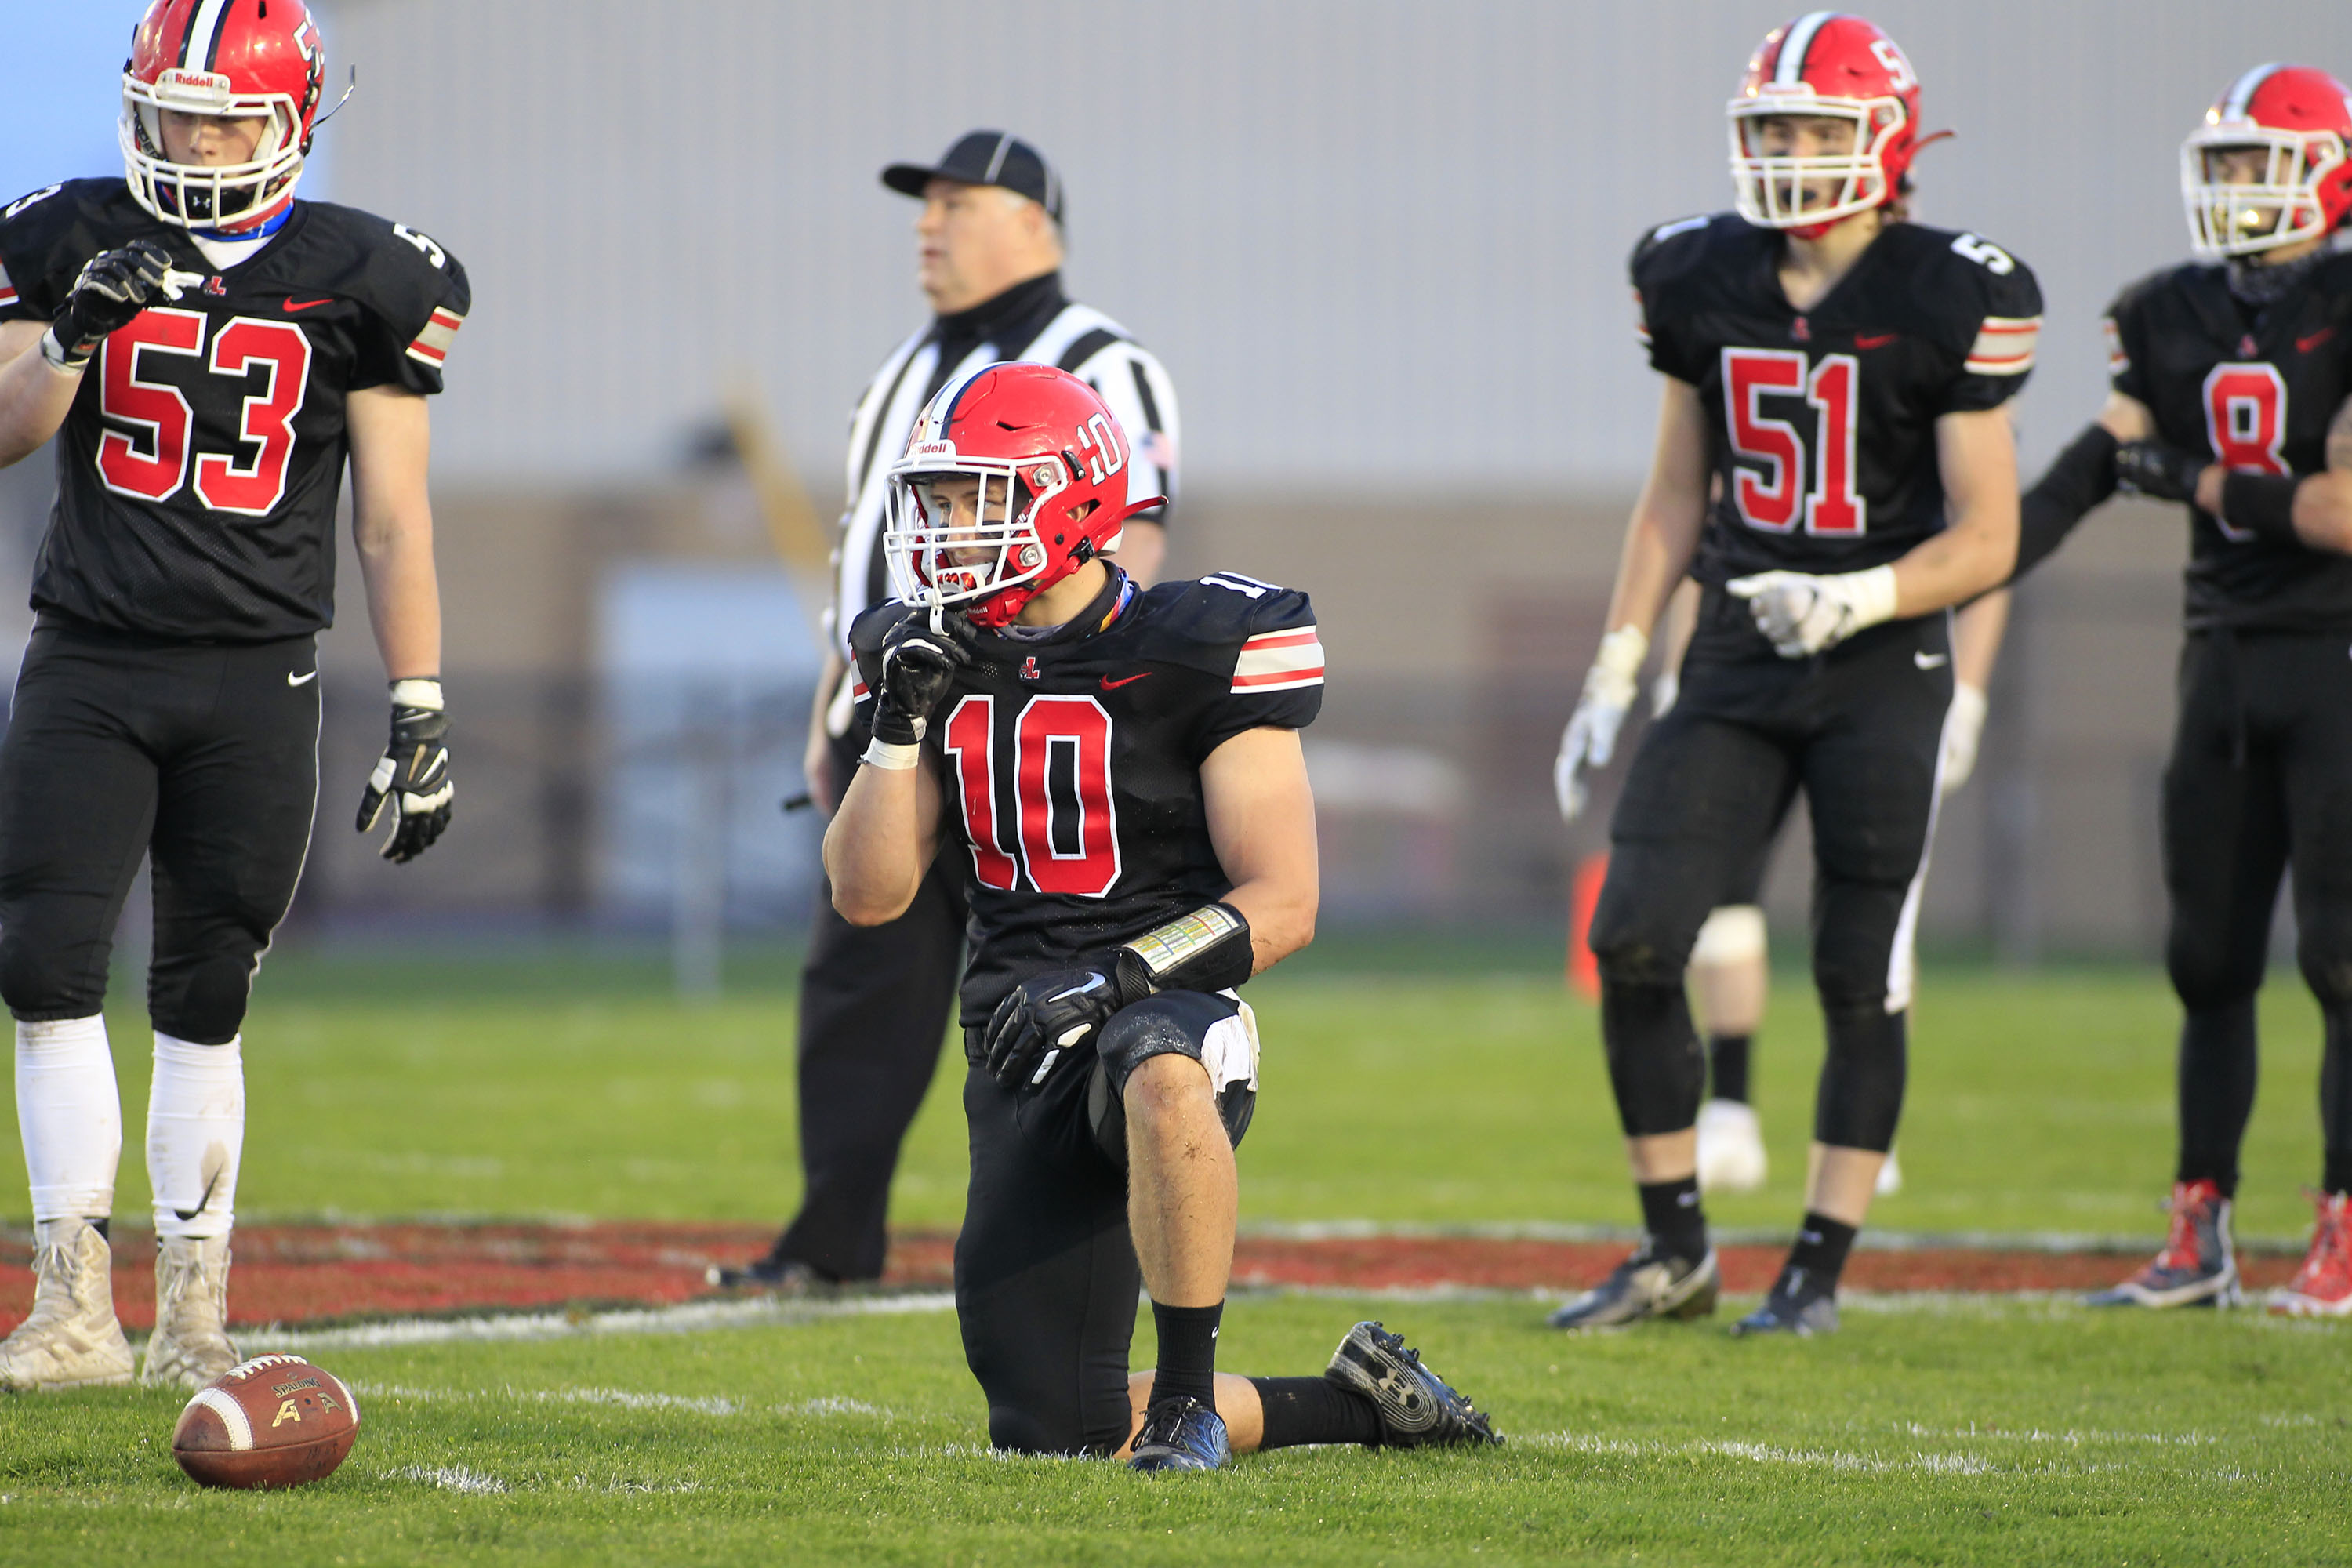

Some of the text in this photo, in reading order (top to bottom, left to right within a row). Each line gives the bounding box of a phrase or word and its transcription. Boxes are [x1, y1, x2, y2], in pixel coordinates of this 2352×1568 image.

[293, 7, 325, 81] 5
[1869, 38, 1918, 91] 5
[394, 223, 446, 270] 5
[1951, 233, 2015, 276] 5
[95, 306, 312, 517] 53
[914, 442, 947, 455] ddell
[1721, 346, 1867, 538] 51
[1076, 412, 1123, 487] 10
[2202, 361, 2293, 543] 8
[944, 694, 1122, 898] 10
[271, 1377, 323, 1398] SPALDING
